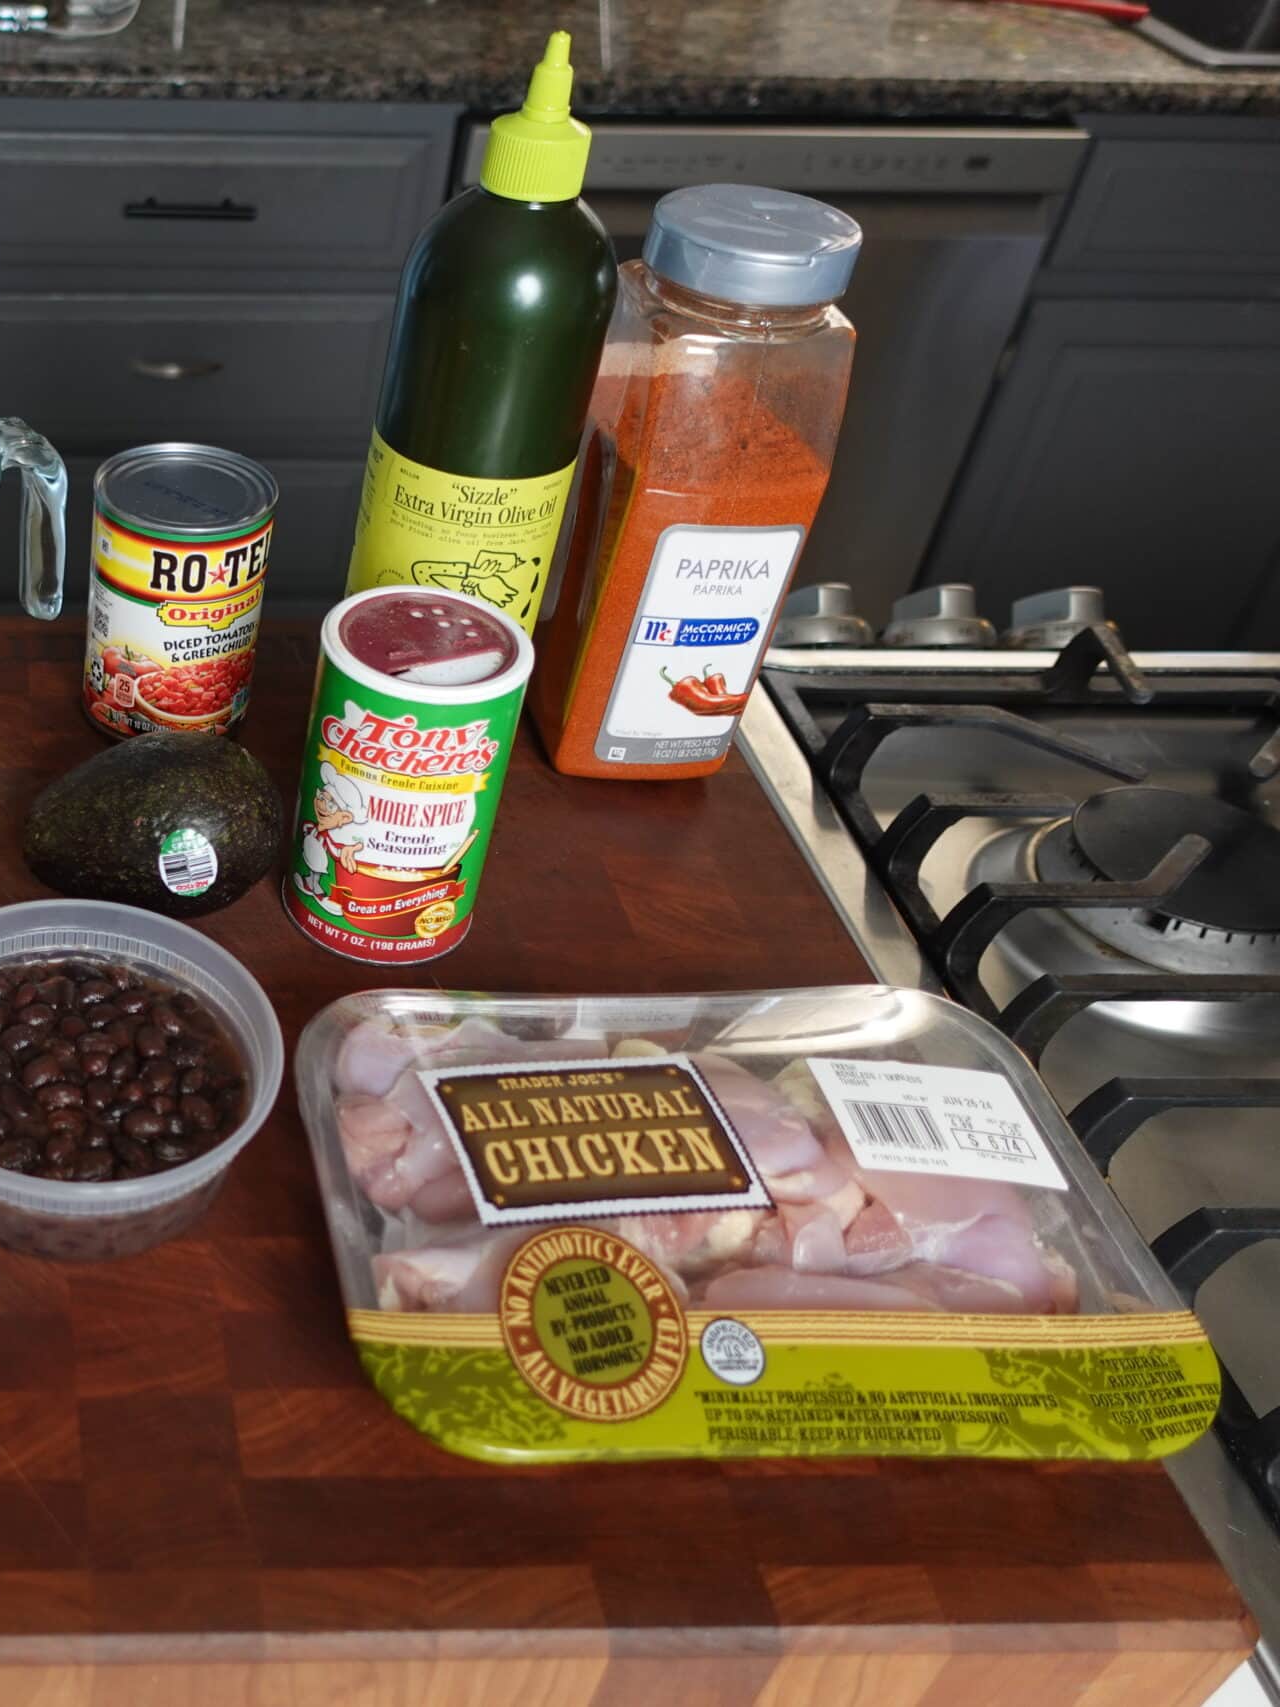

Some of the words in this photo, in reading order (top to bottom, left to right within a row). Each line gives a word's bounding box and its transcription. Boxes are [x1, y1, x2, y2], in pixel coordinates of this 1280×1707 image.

[394, 484, 434, 516] Extra
[441, 501, 492, 528] Virgin
[498, 505, 536, 524] Olive
[539, 496, 558, 517] Oil
[675, 558, 770, 580] PAPRIKA
[692, 584, 743, 596] PAPRIKA
[168, 589, 261, 623] Original
[163, 637, 202, 651] DICED
[680, 632, 750, 642] CULINARY
[171, 653, 180, 663] &
[183, 645, 221, 661] GREEN
[119, 679, 131, 693] 25
[361, 711, 489, 752] Tony
[322, 716, 499, 775] Chachere's
[340, 758, 377, 782] Famous
[380, 774, 416, 788] Creole
[419, 777, 459, 791] Cuisine
[369, 795, 418, 828] MORE
[420, 799, 467, 828] SPICE
[367, 837, 447, 856] Seasoning
[385, 830, 435, 845] Creole
[348, 901, 377, 915] Great
[380, 902, 392, 913] on
[395, 886, 449, 911] Everything!
[307, 914, 323, 929] NET
[324, 924, 341, 940] WT
[342, 932, 349, 942] 7
[350, 936, 367, 948] OZ.
[370, 939, 393, 951] (198
[396, 937, 437, 951] GRAMS)
[497, 1074, 564, 1091] TRADER
[568, 1072, 615, 1087] JOE'S
[460, 1100, 531, 1133] ALL
[528, 1089, 703, 1126] NATURAL
[484, 1126, 726, 1185] CHICKEN
[508, 1233, 615, 1292] ANTIBIOTICS
[616, 1248, 665, 1302] EVER
[505, 1295, 531, 1326] NO
[520, 1350, 557, 1392] ALL
[557, 1355, 675, 1415] VEGETARIAN
[655, 1317, 682, 1360] FED
[1107, 1369, 1185, 1388] REGULATION
[776, 1390, 854, 1406] PROCESSED
[888, 1390, 967, 1406] ARTIFICIAL
[968, 1392, 1060, 1408] INGREDIENTS
[1089, 1391, 1124, 1408] DOES
[1124, 1389, 1149, 1405] NOT
[1148, 1383, 1198, 1401] PERMIT
[705, 1408, 722, 1422] UP
[724, 1408, 742, 1422] TO
[766, 1408, 833, 1423] RETAINED
[834, 1408, 882, 1423] WATER
[884, 1408, 923, 1423] FROM
[923, 1409, 1010, 1425] PROCESSING
[1153, 1399, 1218, 1420] HORMONES
[799, 1426, 833, 1441] KEEP
[835, 1426, 943, 1442] REFRIGERATED
